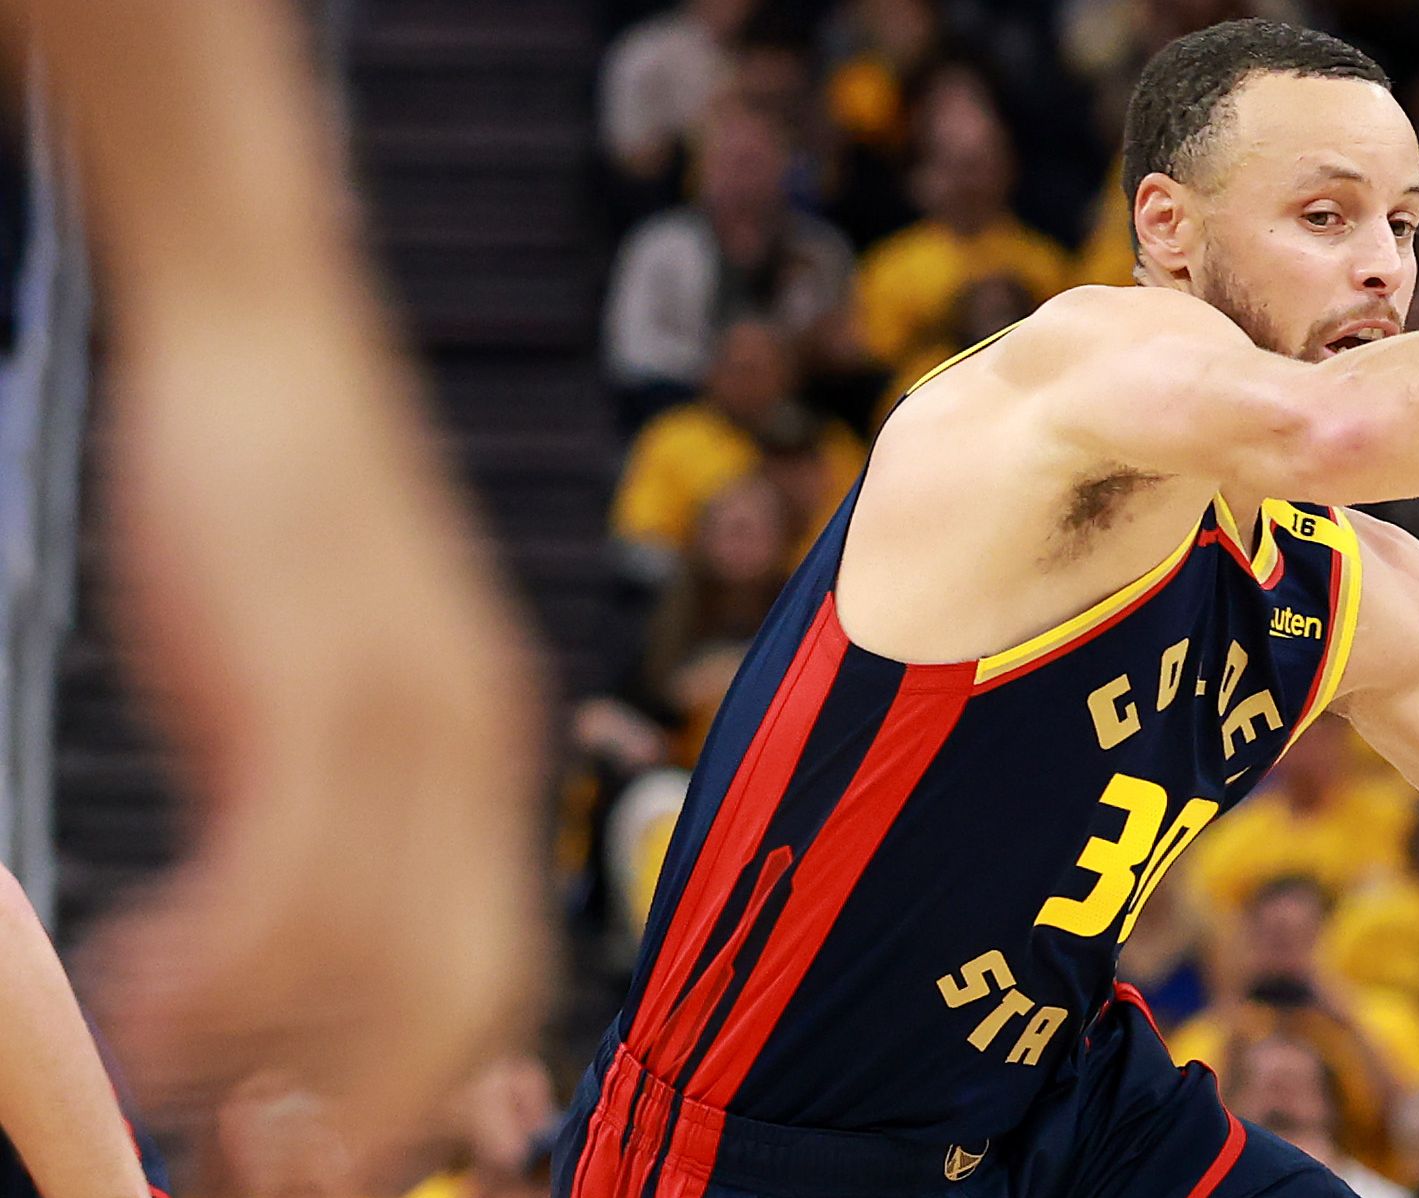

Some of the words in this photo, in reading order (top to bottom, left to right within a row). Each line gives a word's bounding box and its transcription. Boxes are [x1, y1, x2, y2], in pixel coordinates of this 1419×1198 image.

[1292, 513, 1317, 537] 16
[1270, 606, 1323, 640] uten
[1087, 637, 1284, 785] GODE
[1033, 772, 1220, 944] 30
